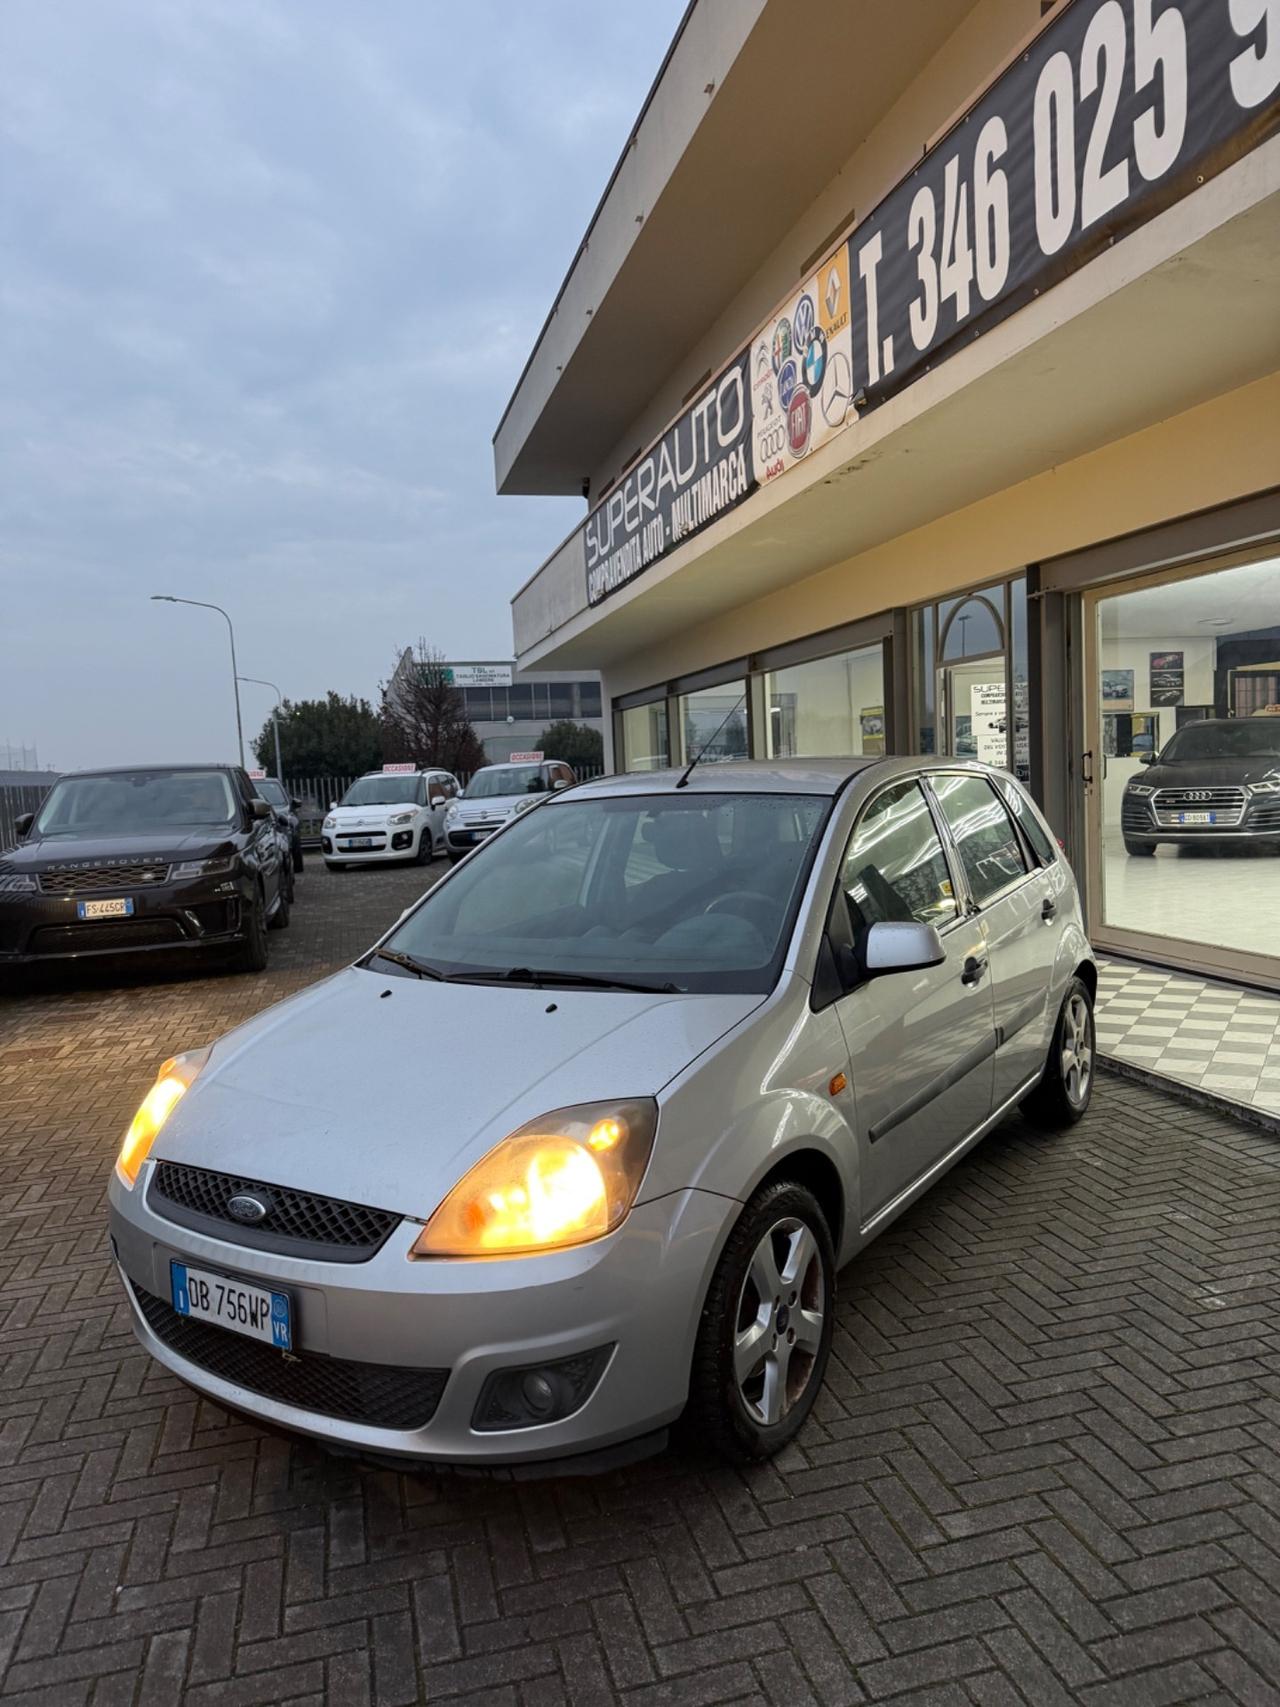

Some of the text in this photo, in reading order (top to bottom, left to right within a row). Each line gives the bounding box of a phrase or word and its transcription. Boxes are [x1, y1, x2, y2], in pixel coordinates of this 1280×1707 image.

[859, 231, 895, 387] T.
[907, 116, 1010, 352] 346
[1033, 0, 1188, 256] 025
[791, 402, 807, 439] FIAT
[586, 366, 744, 568] SUPERAUTO
[766, 457, 785, 480] Audi
[643, 513, 665, 566] AUTO
[671, 443, 748, 542] MULTIMARCA
[47, 856, 163, 871] RANGE ROVER
[188, 1277, 210, 1311] DB
[215, 1284, 270, 1331] 756WP
[273, 1320, 288, 1343] VR
